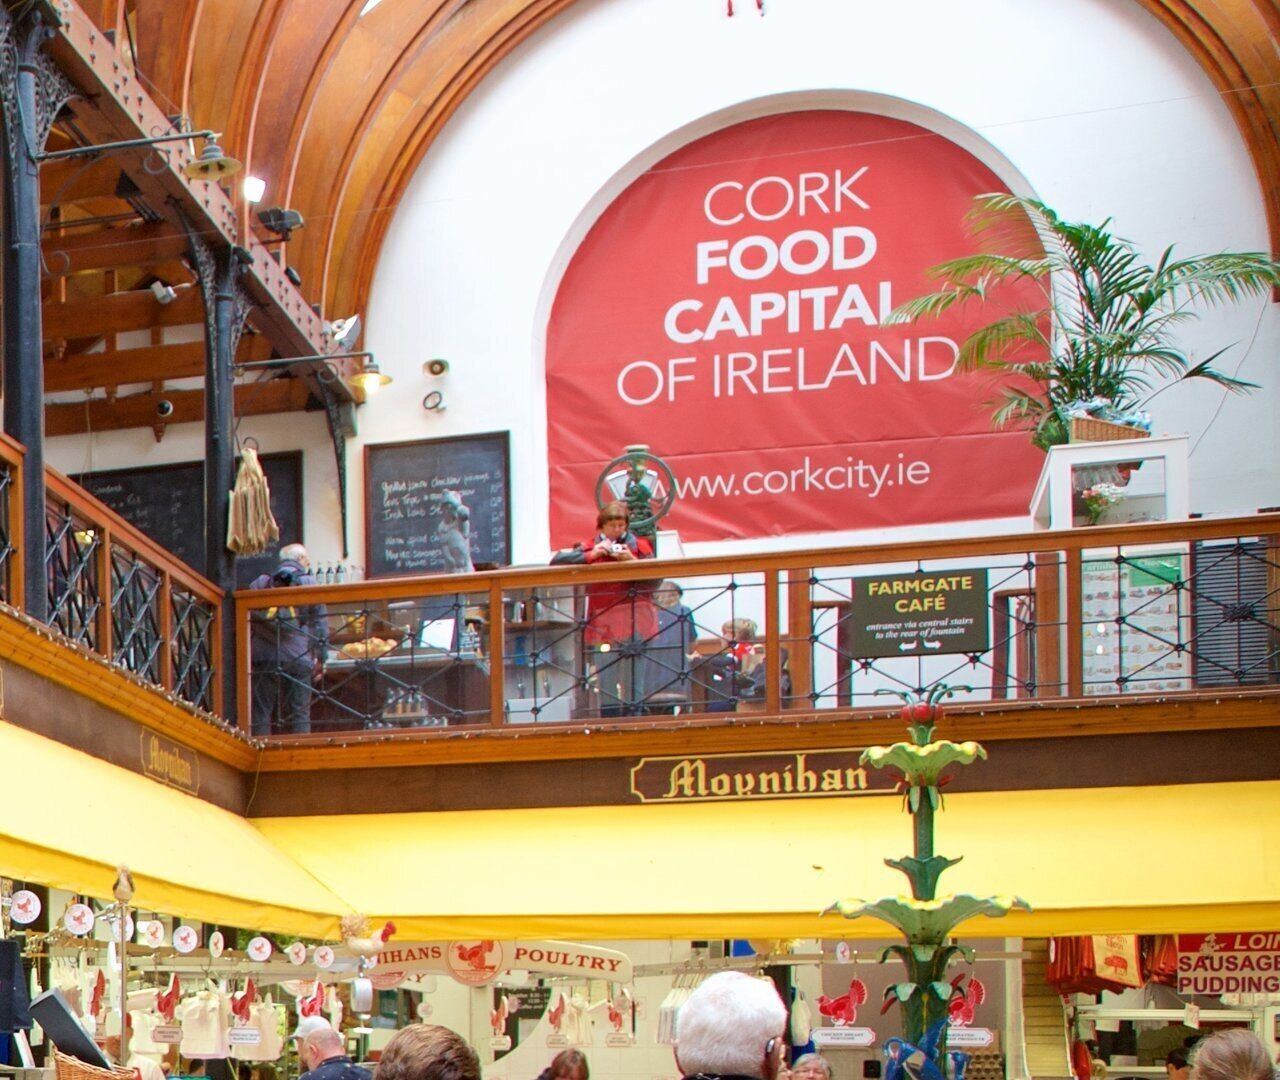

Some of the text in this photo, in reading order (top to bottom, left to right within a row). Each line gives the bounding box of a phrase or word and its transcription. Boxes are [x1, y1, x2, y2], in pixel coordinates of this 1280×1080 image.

[703, 165, 870, 227] CORK
[696, 225, 877, 286] FOOD
[663, 281, 911, 345] CAPITAL
[616, 335, 960, 406] OF IRELAND
[868, 576, 973, 596] FARMGATE
[894, 595, 946, 613] CAFÉ
[866, 616, 974, 632] entrance via central stairs
[875, 626, 965, 640] to the rear of fountain
[663, 754, 869, 800] Moynihan
[378, 946, 622, 973] NIHANS POULTRY
